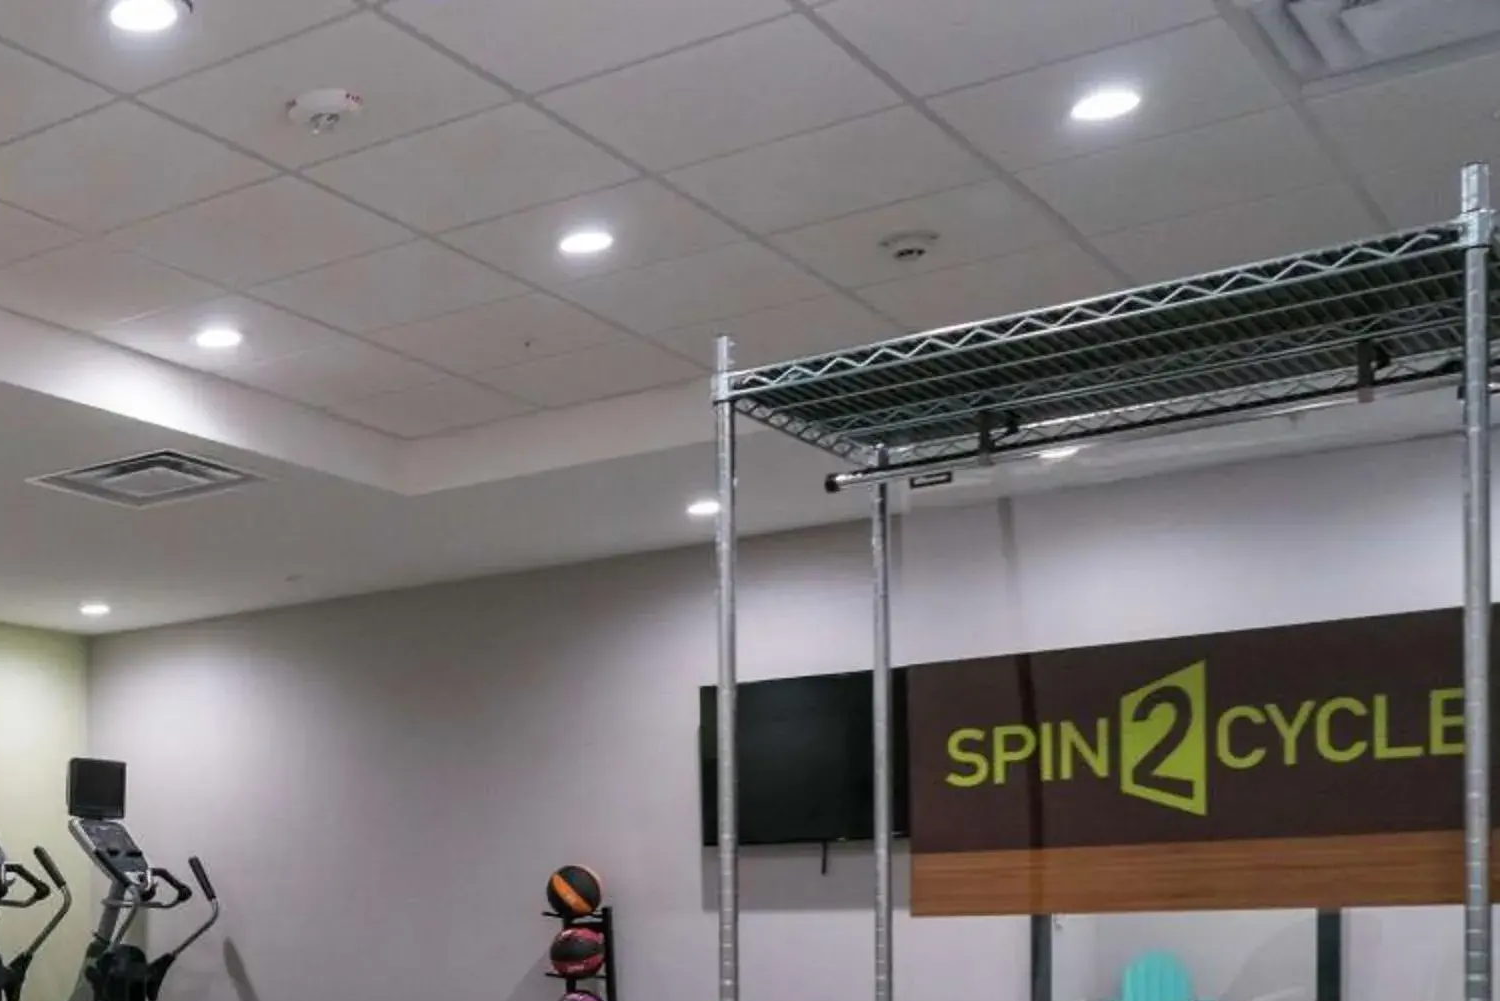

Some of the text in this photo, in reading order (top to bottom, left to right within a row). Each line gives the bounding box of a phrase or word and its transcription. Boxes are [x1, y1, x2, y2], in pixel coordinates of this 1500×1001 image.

[945, 682, 1465, 801] SPIN 2 CYCLE
